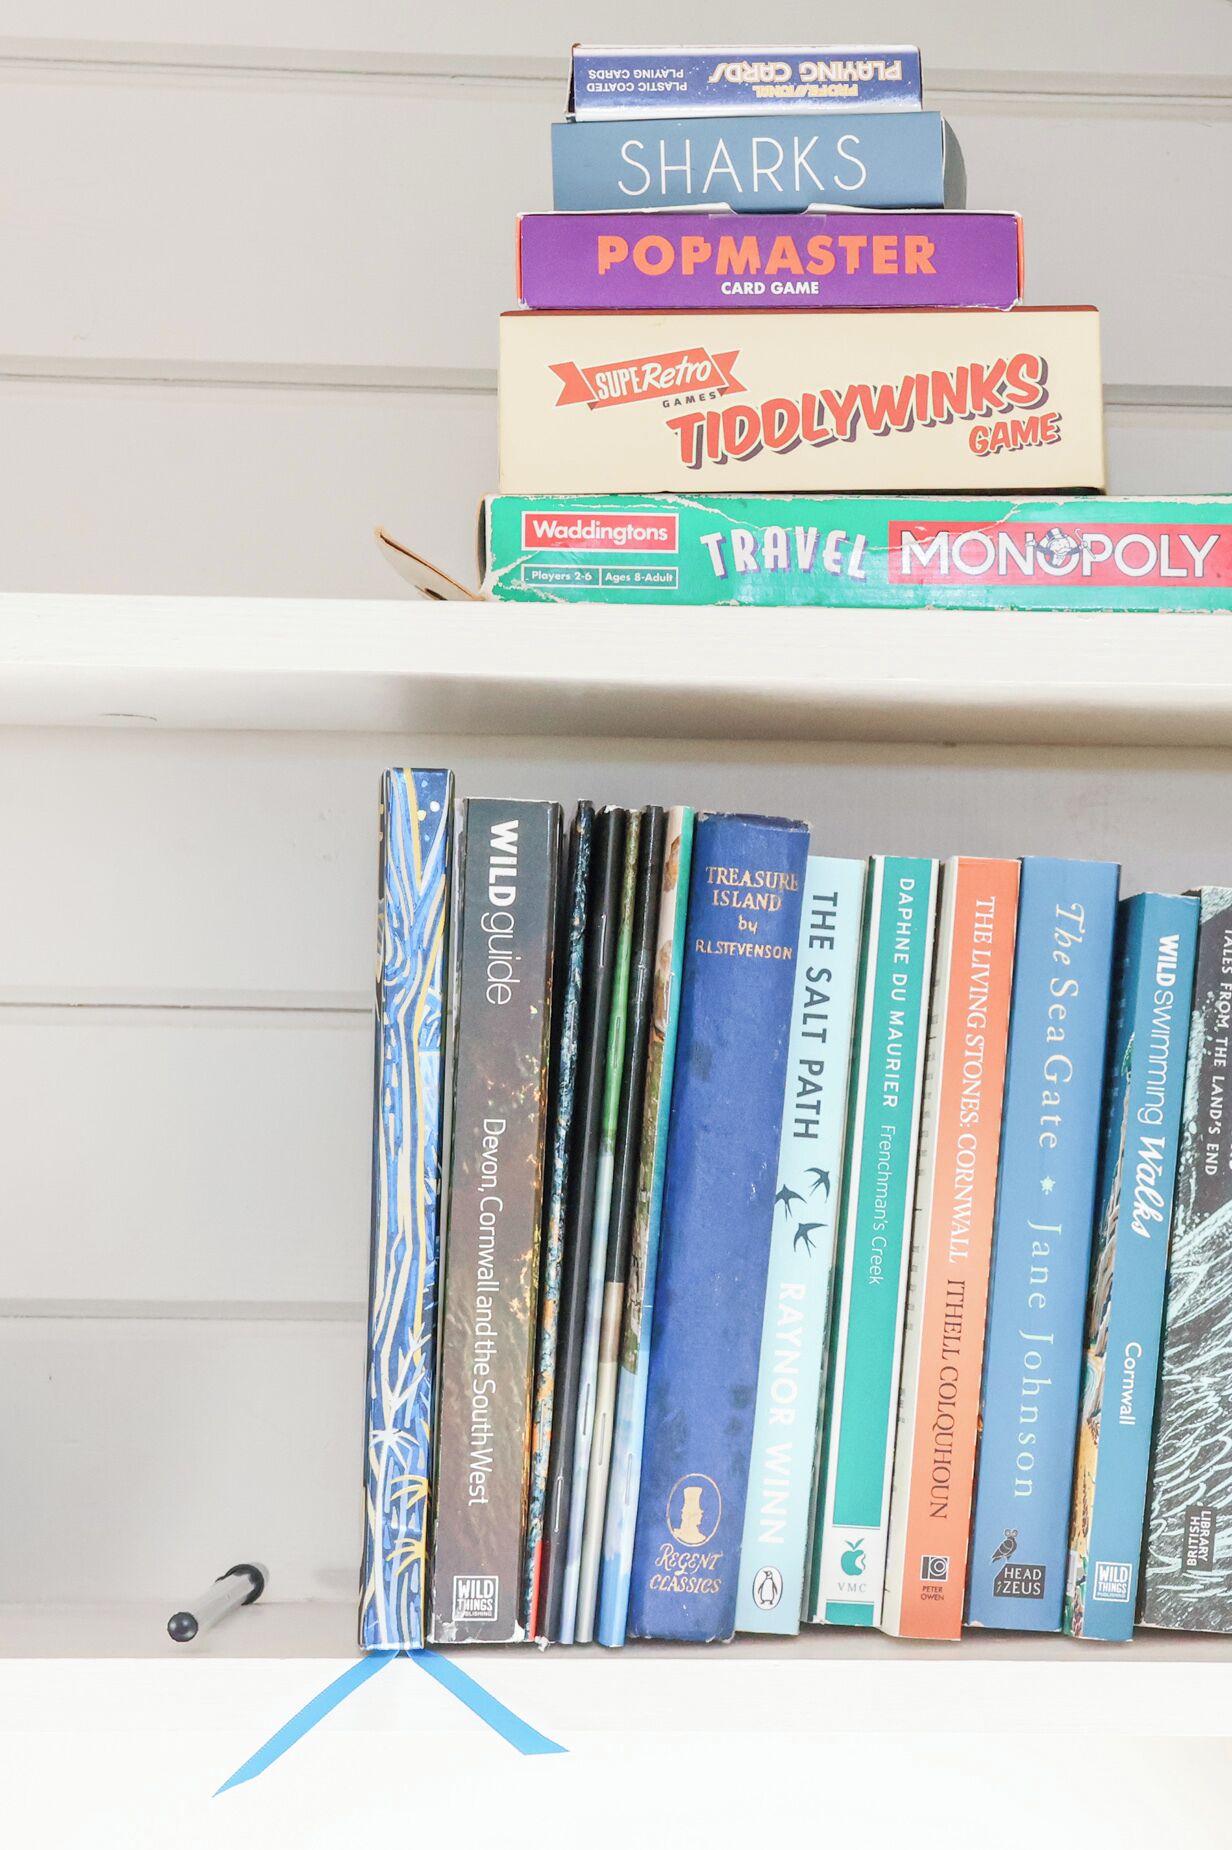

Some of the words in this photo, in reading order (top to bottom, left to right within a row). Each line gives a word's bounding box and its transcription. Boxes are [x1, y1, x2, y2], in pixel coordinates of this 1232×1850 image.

[587, 82, 634, 92] COATED
[588, 69, 630, 80] CARDS
[633, 69, 683, 80] PLAYING
[638, 81, 687, 92] PLASTIC
[708, 61, 792, 83] CARDS
[800, 60, 903, 82] PLAYING
[617, 134, 867, 195] SHARKS
[597, 235, 937, 276] POPMASTER
[721, 282, 766, 296] CARD
[770, 281, 819, 295] GAME
[662, 391, 717, 408] GAMES
[665, 352, 1049, 470] TIDDLYWINKS
[969, 412, 1062, 457] GAME
[532, 519, 669, 545] Waddingtons
[699, 525, 870, 581] TRAVEL
[900, 528, 1221, 578] MONOPOLY
[531, 570, 571, 581] Players
[574, 571, 592, 581] 2-6
[605, 572, 630, 583] Ages
[634, 572, 674, 582] 8-Adult
[712, 889, 783, 912] ISLAND
[738, 914, 758, 935] by
[809, 891, 838, 951] THE
[893, 878, 915, 964] DAPHNE
[973, 896, 996, 944] THE
[1051, 903, 1086, 966] The
[801, 967, 832, 1043] SALT
[891, 974, 908, 1001] DU
[966, 949, 991, 1028] LIVING
[883, 1010, 904, 1108] MAURIER
[1214, 1037, 1228, 1067] THE
[793, 1059, 825, 1139] PATH
[960, 1034, 985, 1127] STONES:
[1208, 1076, 1225, 1135] LAND'S
[478, 1118, 506, 1192] Devon,
[873, 1125, 896, 1231] Frenchman's
[1205, 1144, 1219, 1176] END
[948, 1132, 978, 1264] CORNWALL
[1129, 1136, 1166, 1239] Walks
[477, 1196, 503, 1292] Cornwall
[869, 1236, 887, 1285] Creek
[1027, 1219, 1062, 1309] Jane
[475, 1296, 498, 1335] and
[942, 1279, 965, 1360] ITHELL
[473, 1341, 497, 1375] the
[769, 1282, 806, 1426] RAYNOR
[1119, 1342, 1142, 1425] Cornwall
[471, 1379, 496, 1445] South
[1013, 1330, 1054, 1498] Johnson
[929, 1366, 959, 1520] COLQUHOUN
[469, 1448, 494, 1506] West
[757, 1442, 796, 1544] WINN
[655, 1544, 723, 1575] REGENT
[1187, 1516, 1201, 1566] BRITISH
[1197, 1510, 1211, 1562] LIBRARY
[458, 1579, 494, 1598] WILD
[649, 1570, 722, 1594] CLASSICS
[920, 1593, 944, 1601] OWEN
[1003, 1581, 1041, 1595] ZEUS
[1004, 1567, 1042, 1580] HEAD
[1098, 1582, 1127, 1594] THINGS
[1099, 1565, 1128, 1583] WILD
[457, 1598, 493, 1611] THINGS
